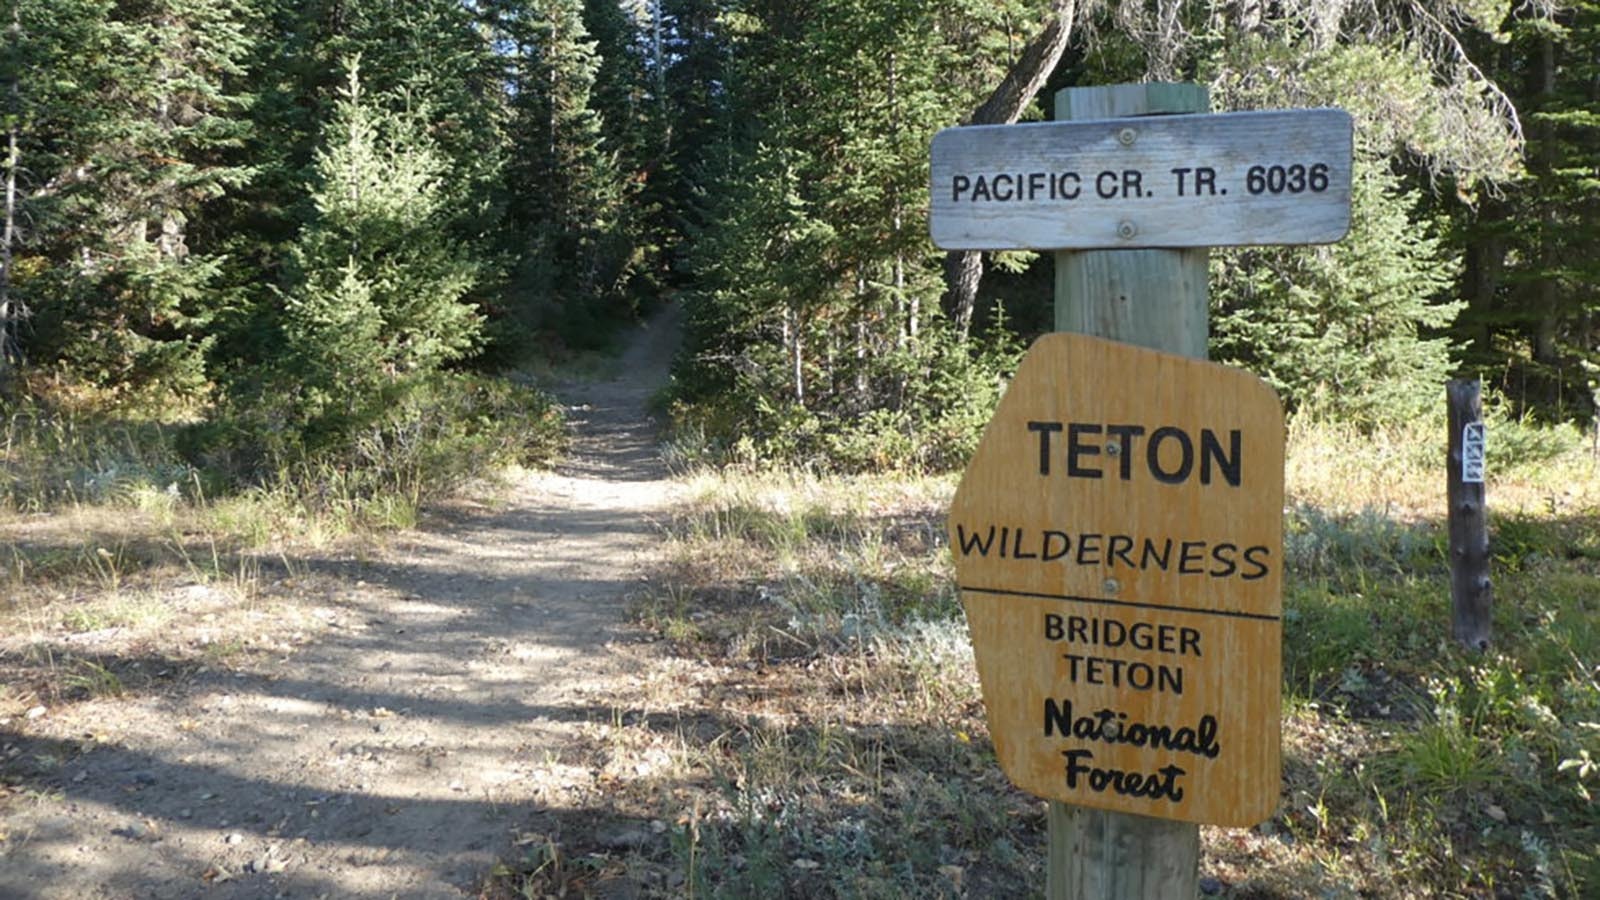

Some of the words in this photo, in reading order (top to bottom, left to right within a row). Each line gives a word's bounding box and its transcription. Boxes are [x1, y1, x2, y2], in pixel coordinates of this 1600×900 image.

[952, 172, 1081, 202] PACIFIC
[1095, 170, 1152, 199] CR.
[1171, 168, 1227, 196] TR.
[1246, 163, 1329, 195] 6036
[1027, 421, 1242, 487] TETON
[957, 524, 1270, 580] WILDERNESS
[1044, 613, 1202, 657] BRIDGER
[1063, 654, 1183, 694] TETON
[1044, 697, 1220, 759] National
[1062, 749, 1186, 802] Forest
